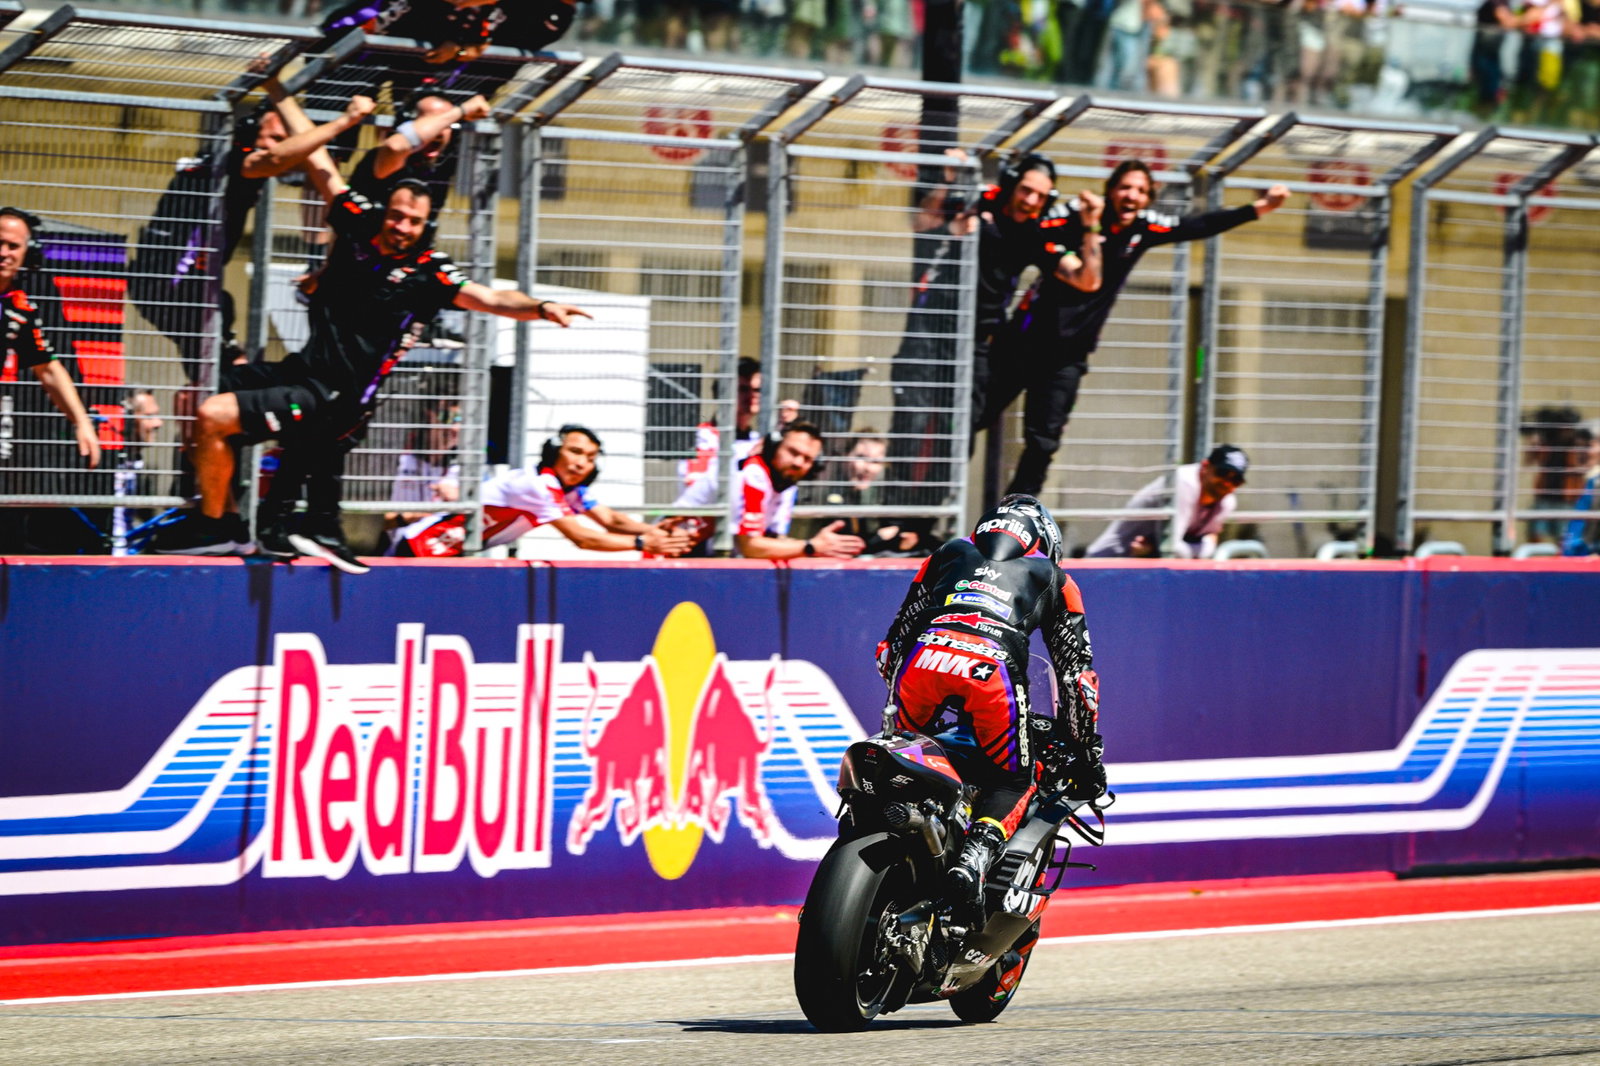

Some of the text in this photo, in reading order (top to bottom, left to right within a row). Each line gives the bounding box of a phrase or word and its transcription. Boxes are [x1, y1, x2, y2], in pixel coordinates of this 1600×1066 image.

[975, 518, 1033, 547] aprilia
[974, 566, 1002, 580] sky
[969, 581, 1011, 601] Castr
[916, 631, 1009, 661] alpinestars
[914, 648, 983, 679] MVK
[1015, 683, 1030, 767] alpinestars
[269, 636, 557, 864] Red Bull
